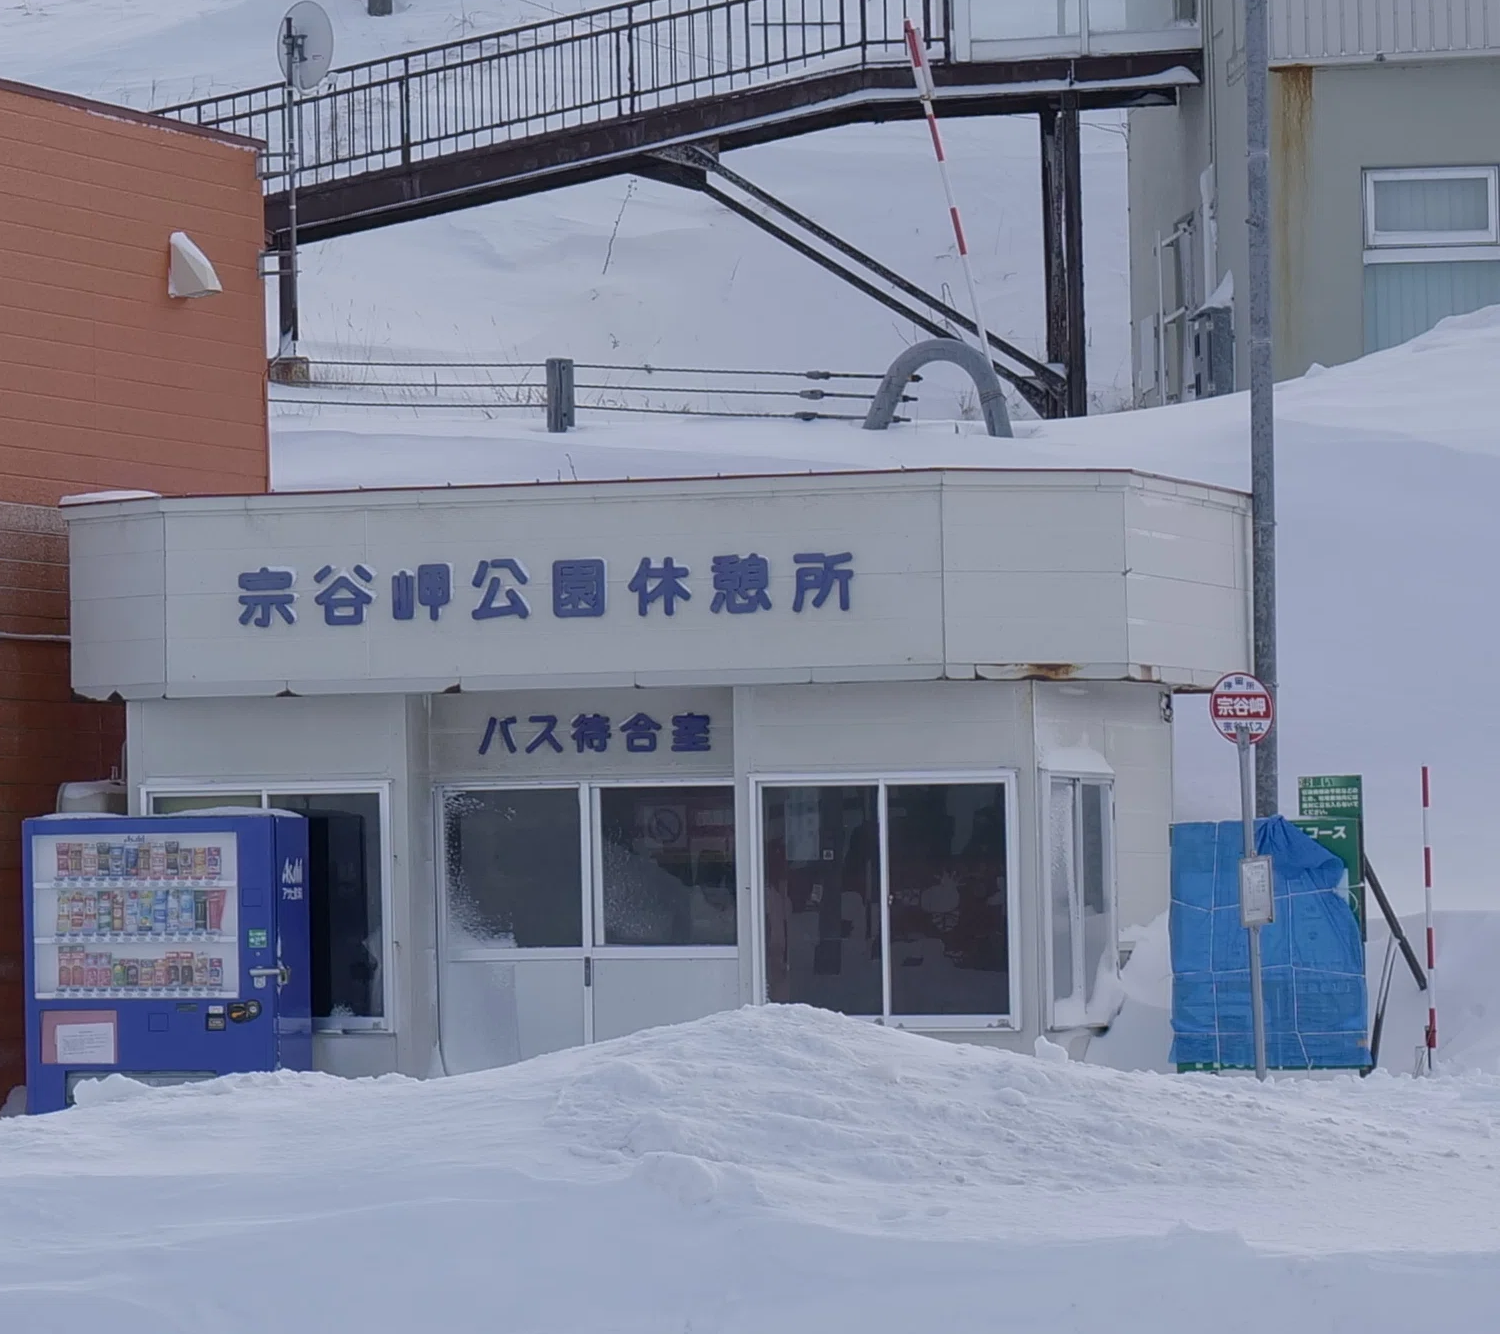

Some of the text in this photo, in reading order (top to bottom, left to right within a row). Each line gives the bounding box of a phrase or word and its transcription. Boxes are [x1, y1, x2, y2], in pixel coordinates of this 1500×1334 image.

[237, 550, 856, 627] 宗谷岬公園休憩所
[1217, 697, 1265, 716] 宗谷岬
[477, 711, 713, 756] バス待合室
[1299, 825, 1347, 839] コース
